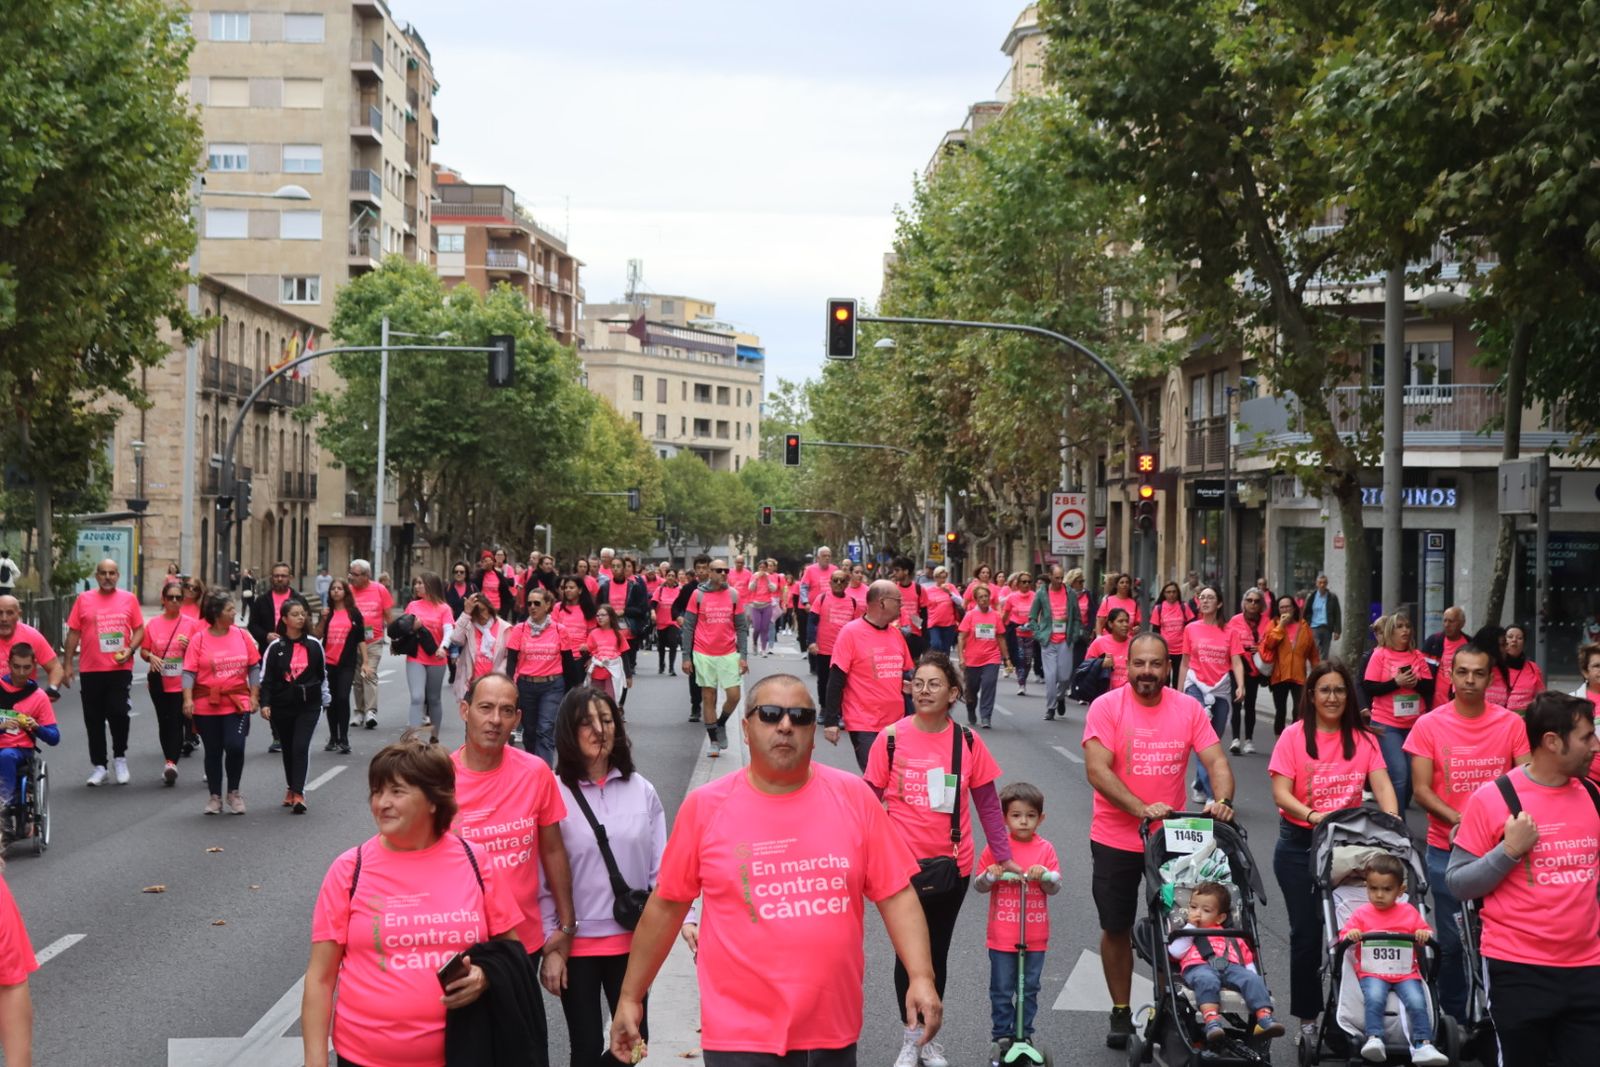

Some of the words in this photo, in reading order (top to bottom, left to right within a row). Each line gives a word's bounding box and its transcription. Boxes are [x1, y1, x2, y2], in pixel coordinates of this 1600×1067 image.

[1055, 496, 1077, 505] ZBE
[854, 546, 861, 555] P
[1133, 739, 1146, 748] En
[1148, 740, 1185, 749] marcha
[1132, 752, 1172, 762] contra
[1450, 758, 1464, 766] En
[1467, 756, 1506, 766] marcha
[905, 770, 919, 778] En
[1132, 762, 1182, 776] cáncer
[1451, 768, 1492, 780] contra
[1313, 774, 1326, 784] En
[1313, 784, 1354, 796] contra
[462, 826, 480, 838] En
[484, 817, 534, 836] marcha
[485, 837, 520, 852] ntra
[522, 830, 534, 844] el
[1174, 830, 1204, 843] 11465
[1553, 836, 1598, 850] marcha
[752, 860, 776, 876] En
[781, 854, 849, 874] marcha
[1534, 852, 1587, 868] contra
[755, 876, 828, 896] contra
[831, 872, 848, 890] el
[759, 896, 850, 920] cáncer
[384, 913, 408, 927] En
[414, 908, 480, 926] marcha
[385, 928, 461, 948] contra
[464, 926, 480, 944] el
[1373, 948, 1400, 960] 9331
